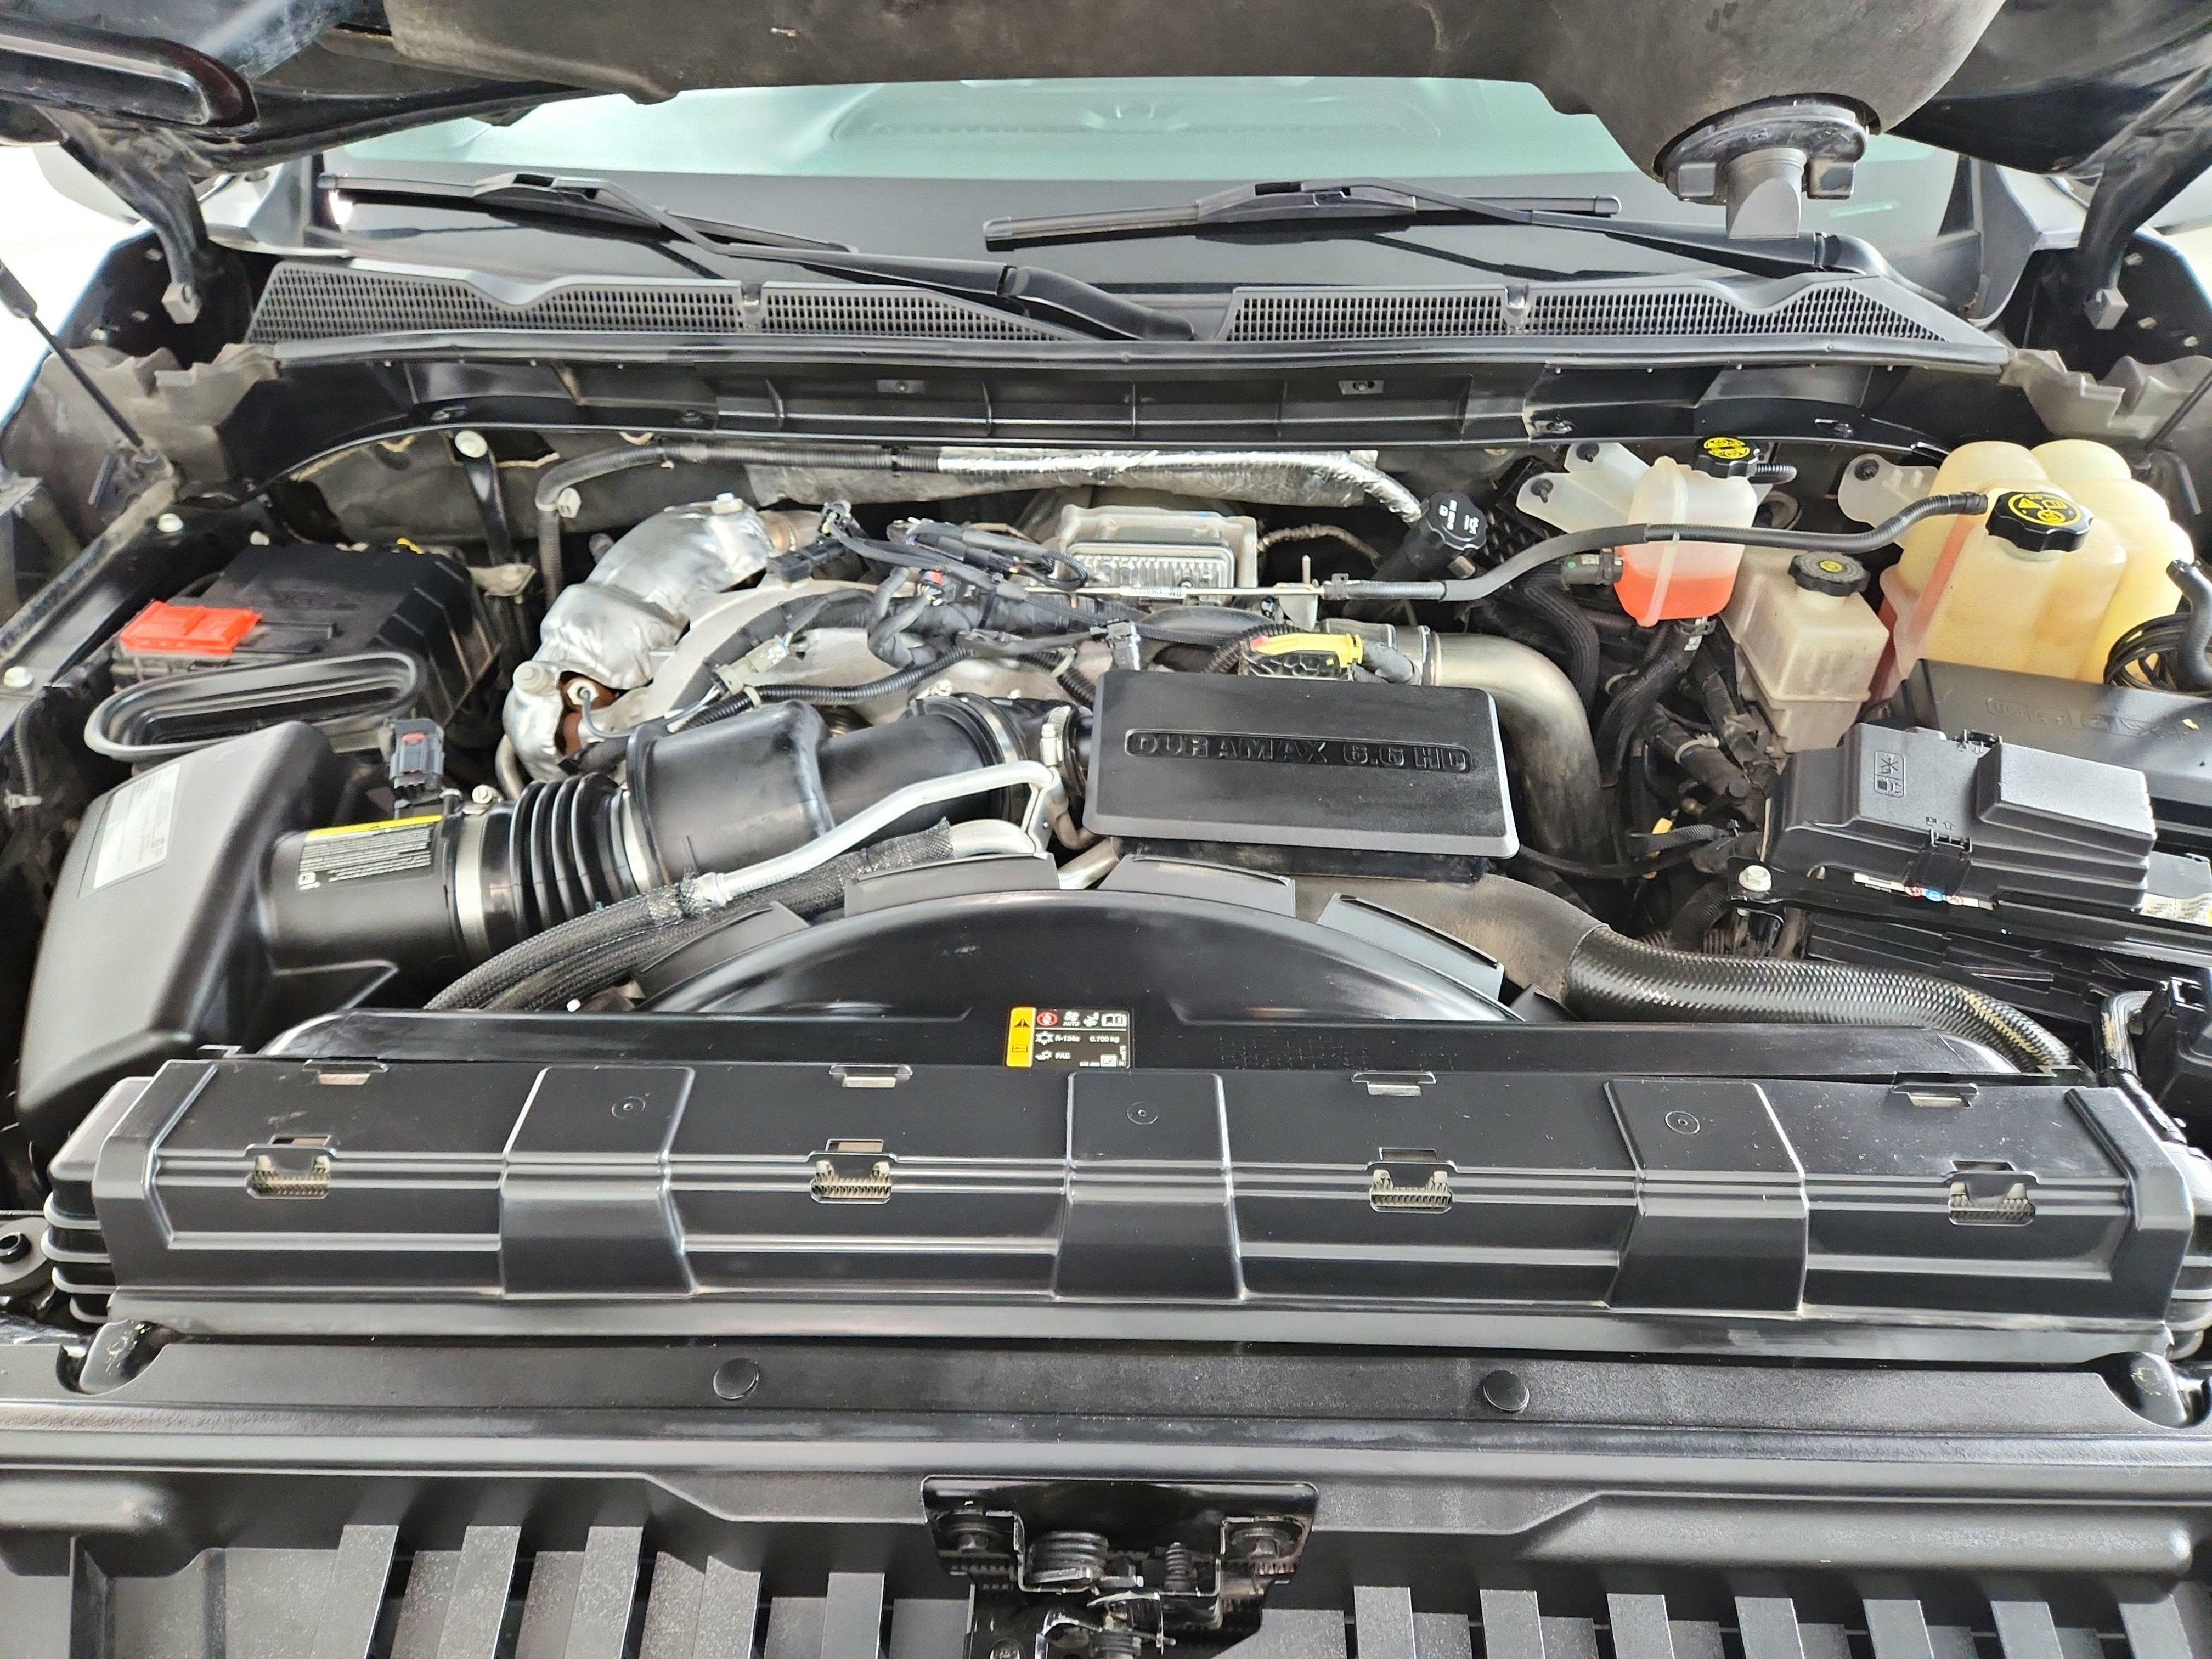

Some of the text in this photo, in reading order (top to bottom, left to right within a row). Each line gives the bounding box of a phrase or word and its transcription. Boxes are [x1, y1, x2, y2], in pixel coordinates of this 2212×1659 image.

[1132, 733, 1466, 770] DURAMAX 6.6 HD
